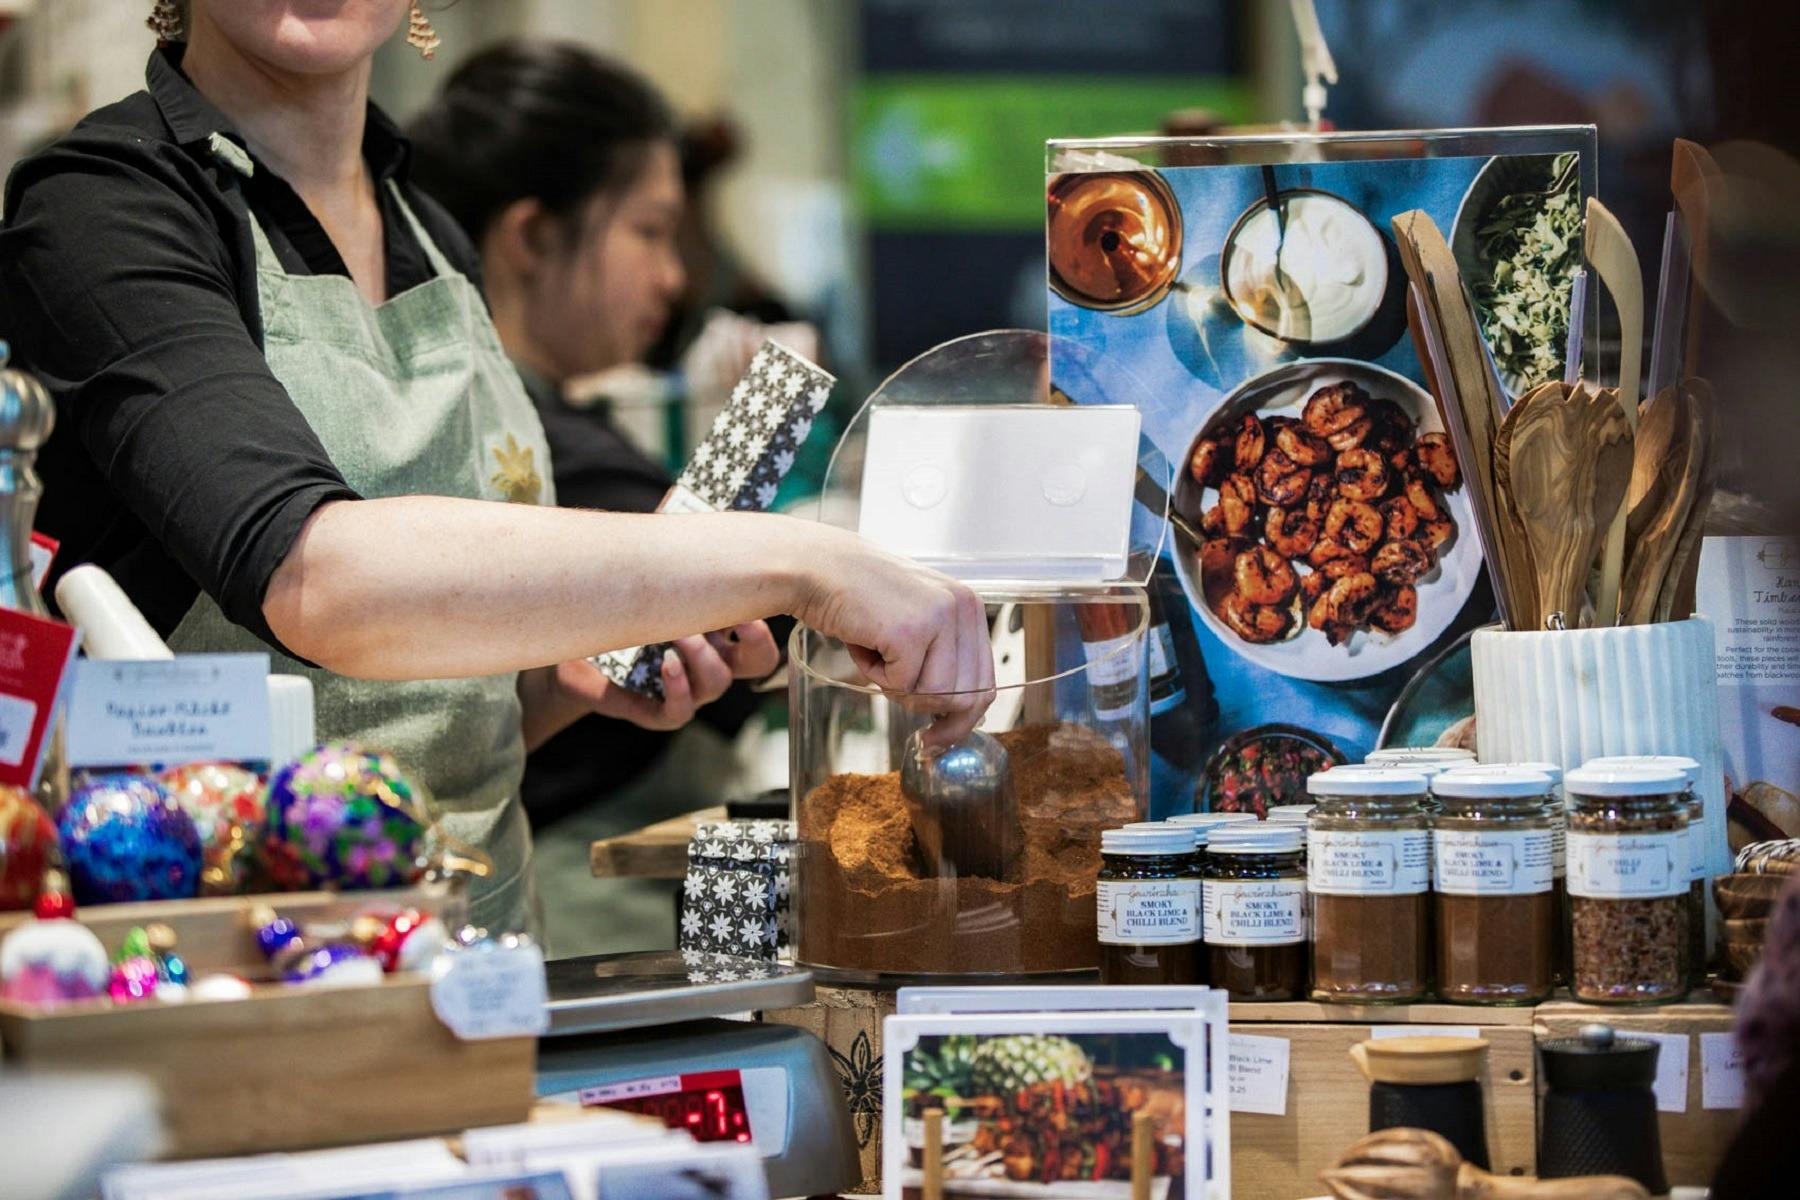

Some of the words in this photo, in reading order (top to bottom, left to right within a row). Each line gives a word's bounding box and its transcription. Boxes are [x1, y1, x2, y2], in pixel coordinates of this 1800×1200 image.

[1140, 901, 1172, 909] SMOKY
[1245, 901, 1278, 910] SMOKY
[1126, 910, 1156, 918] BLACK
[1158, 909, 1180, 917] LIME
[1230, 911, 1262, 919] BLACK
[1264, 910, 1285, 919] LIME
[1126, 918, 1157, 927] CHILLI
[1159, 917, 1188, 926] BLEND
[1230, 920, 1262, 928] CHILLI
[1264, 918, 1294, 927] BLEND
